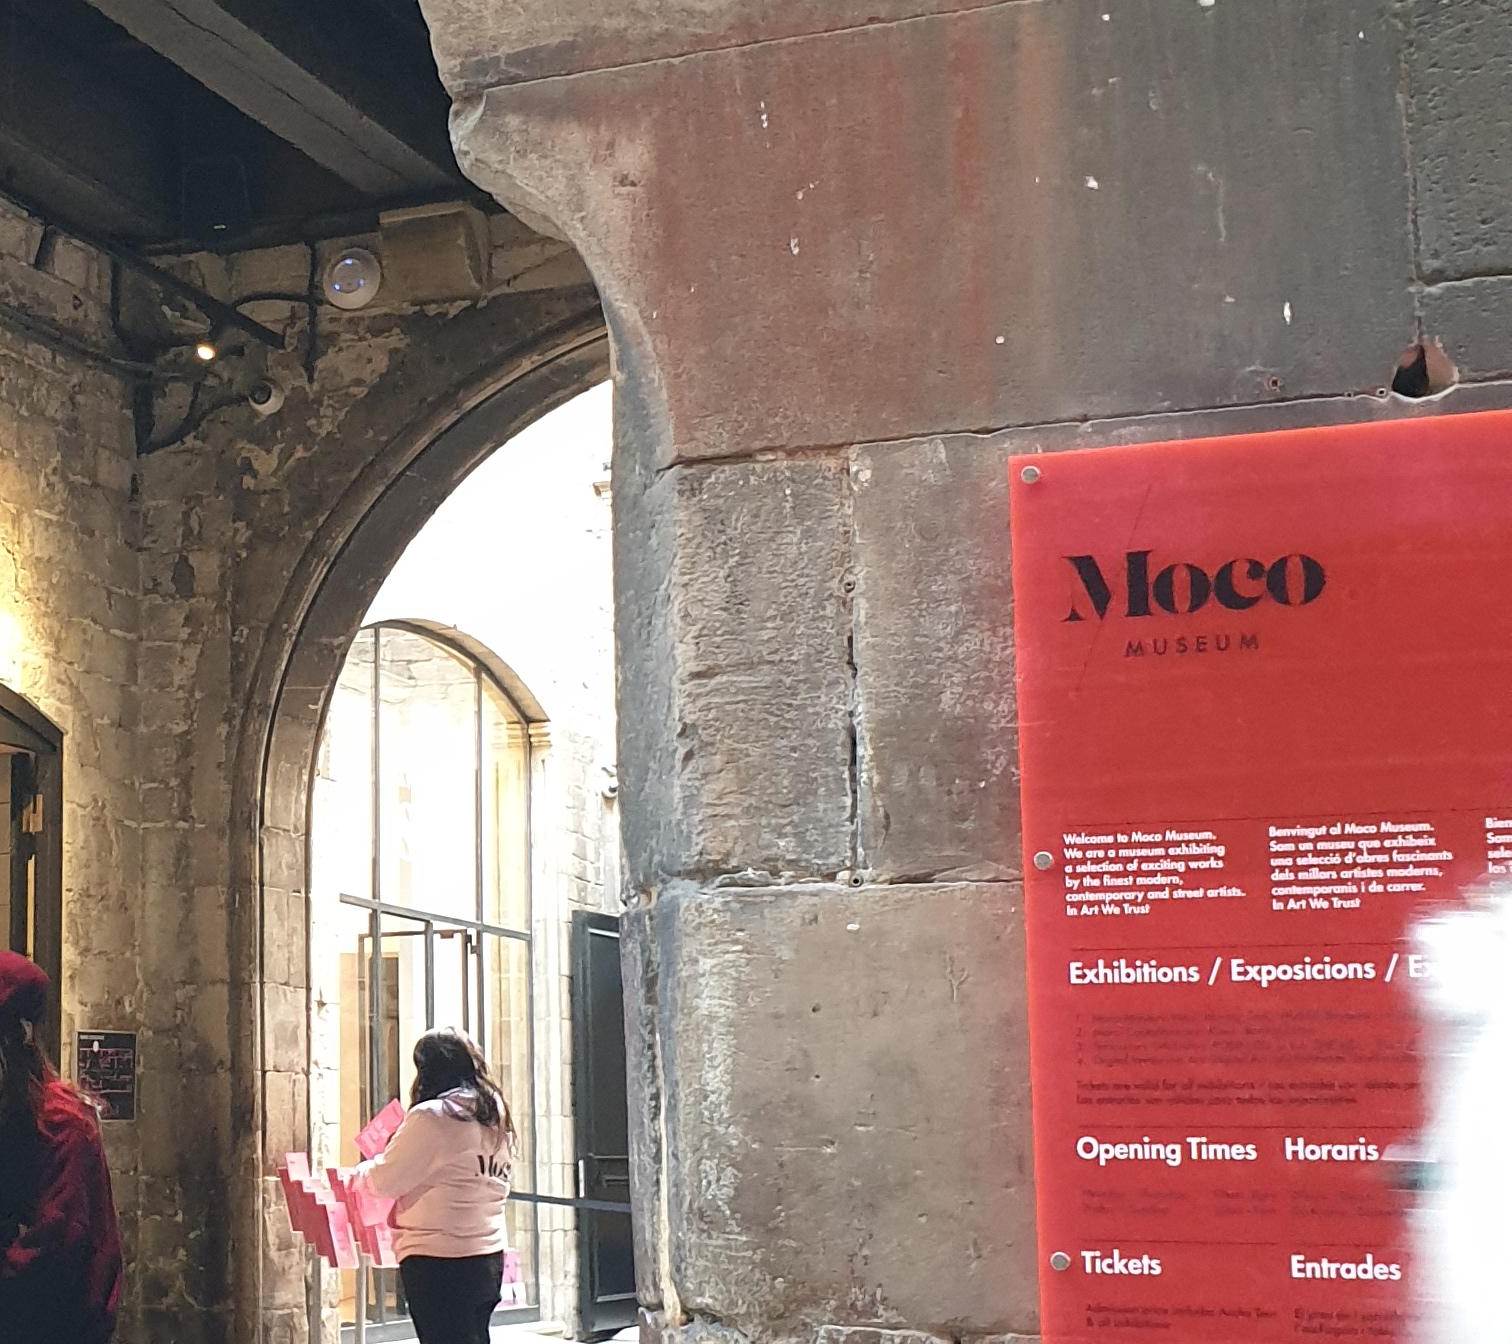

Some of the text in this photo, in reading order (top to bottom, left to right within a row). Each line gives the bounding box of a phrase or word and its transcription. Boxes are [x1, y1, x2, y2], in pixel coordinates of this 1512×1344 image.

[1061, 550, 1326, 622] Moco
[1125, 633, 1260, 657] MUSEUM
[1063, 830, 1216, 845] Welcome to Moco Museum.
[1268, 821, 1434, 838] Benvingut al Moco Museum.
[1064, 847, 1083, 859] We
[1085, 849, 1105, 859] are
[1119, 847, 1165, 857] museum
[1168, 844, 1225, 857] exhibiting
[1269, 840, 1295, 852] Som
[1298, 841, 1313, 851] un
[1317, 840, 1354, 850] museu
[1358, 839, 1381, 854] que
[1065, 857, 1223, 873] a selection of exciting works
[1065, 873, 1183, 890] by the finest modern,
[1368, 880, 1384, 893] de
[1066, 889, 1144, 903] contemporary
[1147, 887, 1169, 899] and
[1172, 887, 1204, 899] street
[1272, 896, 1361, 910] In Art We Trust
[1066, 903, 1150, 916] In Art We Trust
[1069, 958, 1200, 986] Exhibitions
[1207, 957, 1222, 986] /
[1230, 956, 1376, 987] Exposicions
[1384, 953, 1399, 983] /
[1076, 1137, 1258, 1167] Opening Times
[1285, 1137, 1380, 1162] Horaris
[1081, 1250, 1162, 1276] Tickets
[1291, 1253, 1402, 1281] Entrades
